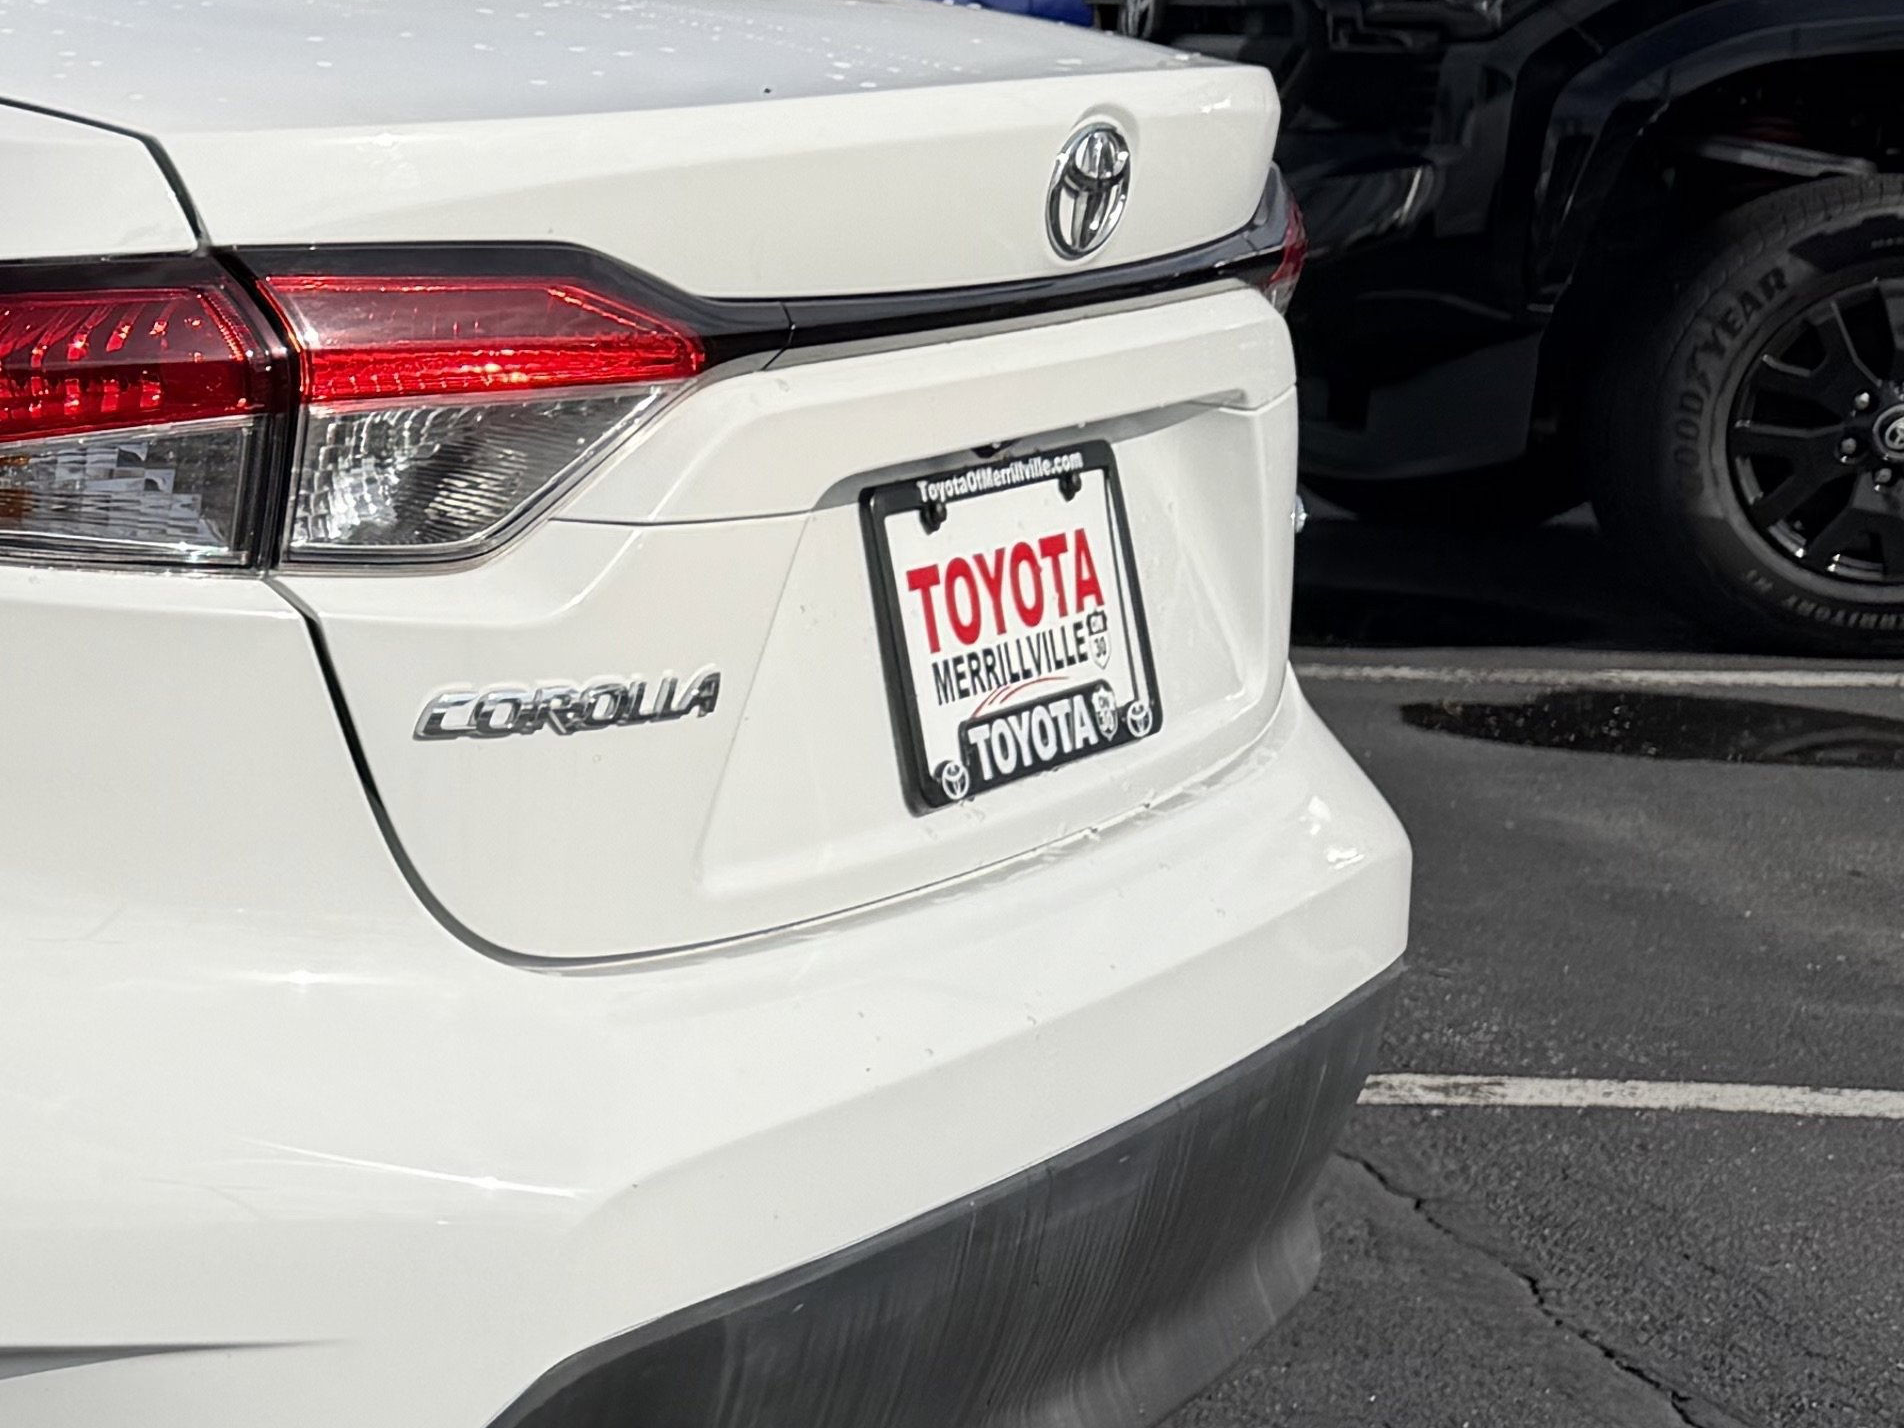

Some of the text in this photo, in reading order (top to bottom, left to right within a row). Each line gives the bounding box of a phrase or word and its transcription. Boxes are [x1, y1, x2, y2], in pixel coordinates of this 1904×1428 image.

[916, 451, 1084, 503] ToyotaOfMerrillville.com
[906, 527, 1105, 655] TOYOTA
[412, 668, 722, 741] COROLLA
[932, 622, 1089, 706] MERRILLVILLE
[968, 694, 1099, 781] TOYOTA
